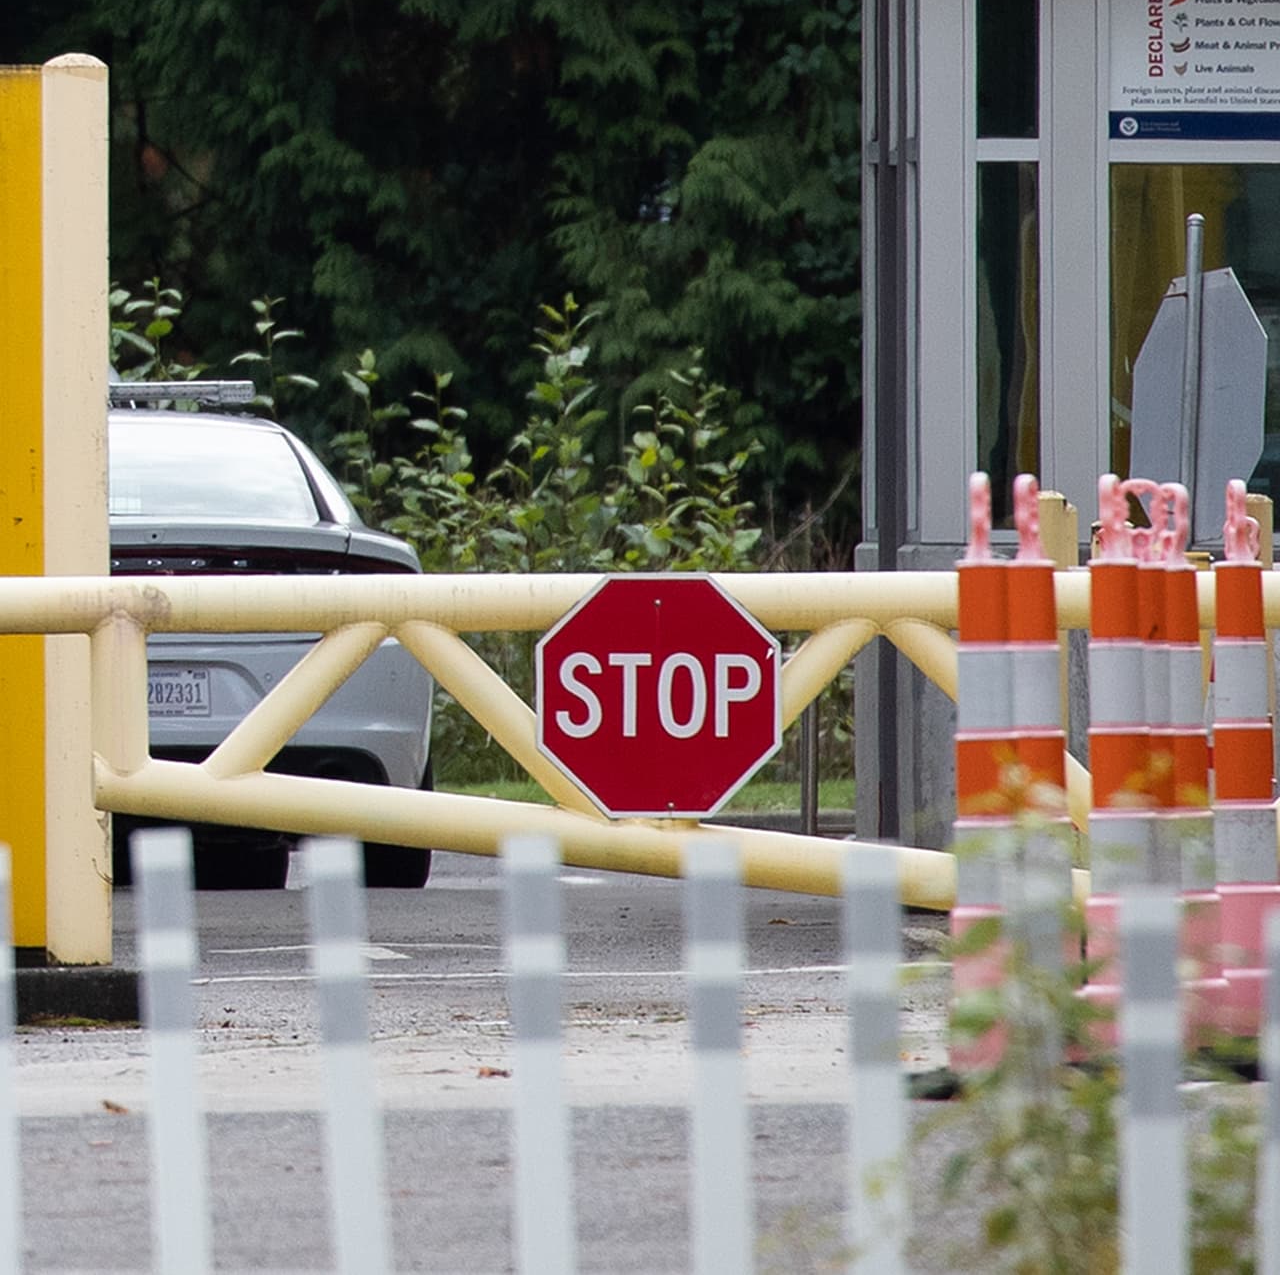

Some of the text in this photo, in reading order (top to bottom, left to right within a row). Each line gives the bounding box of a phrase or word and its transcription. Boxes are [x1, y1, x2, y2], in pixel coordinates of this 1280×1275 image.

[1195, 18, 1224, 27] Plants
[1228, 18, 1236, 26] &
[1238, 18, 1256, 26] Cut
[1195, 41, 1219, 50] Meat
[1223, 41, 1231, 50] &
[1234, 41, 1266, 49] Animal
[1195, 65, 1254, 73] Live Animals
[555, 652, 762, 739] STOP
